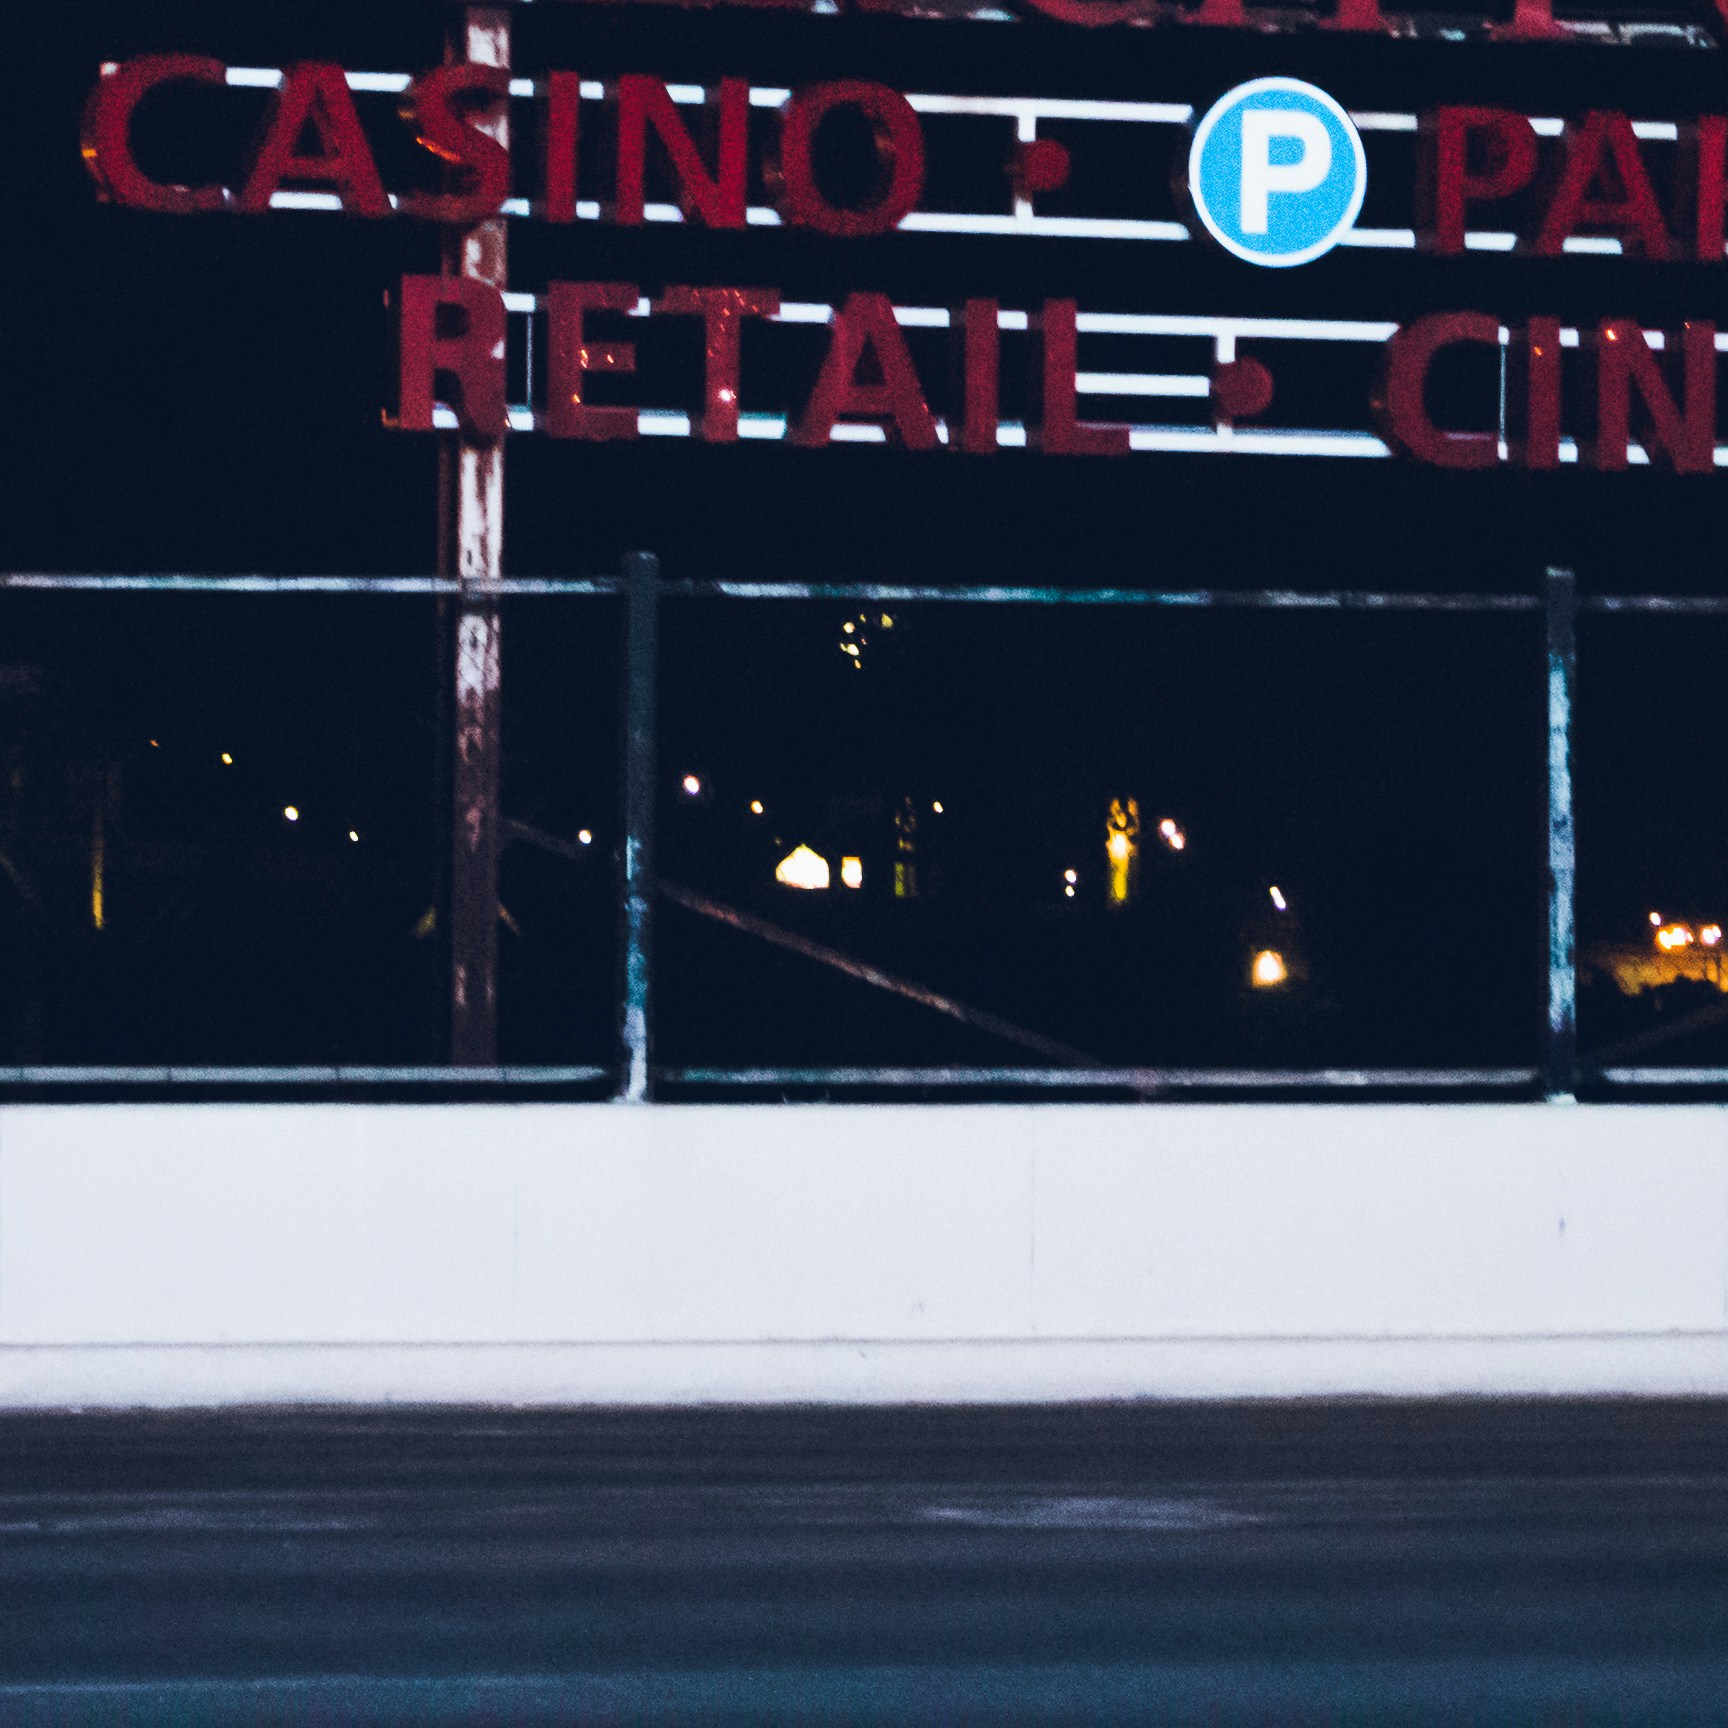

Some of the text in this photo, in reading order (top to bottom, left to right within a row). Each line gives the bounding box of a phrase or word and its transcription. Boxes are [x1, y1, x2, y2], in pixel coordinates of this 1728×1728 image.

[84, 57, 927, 236] CASINO
[1240, 109, 1333, 236] P
[386, 274, 1132, 458] RETAIL
